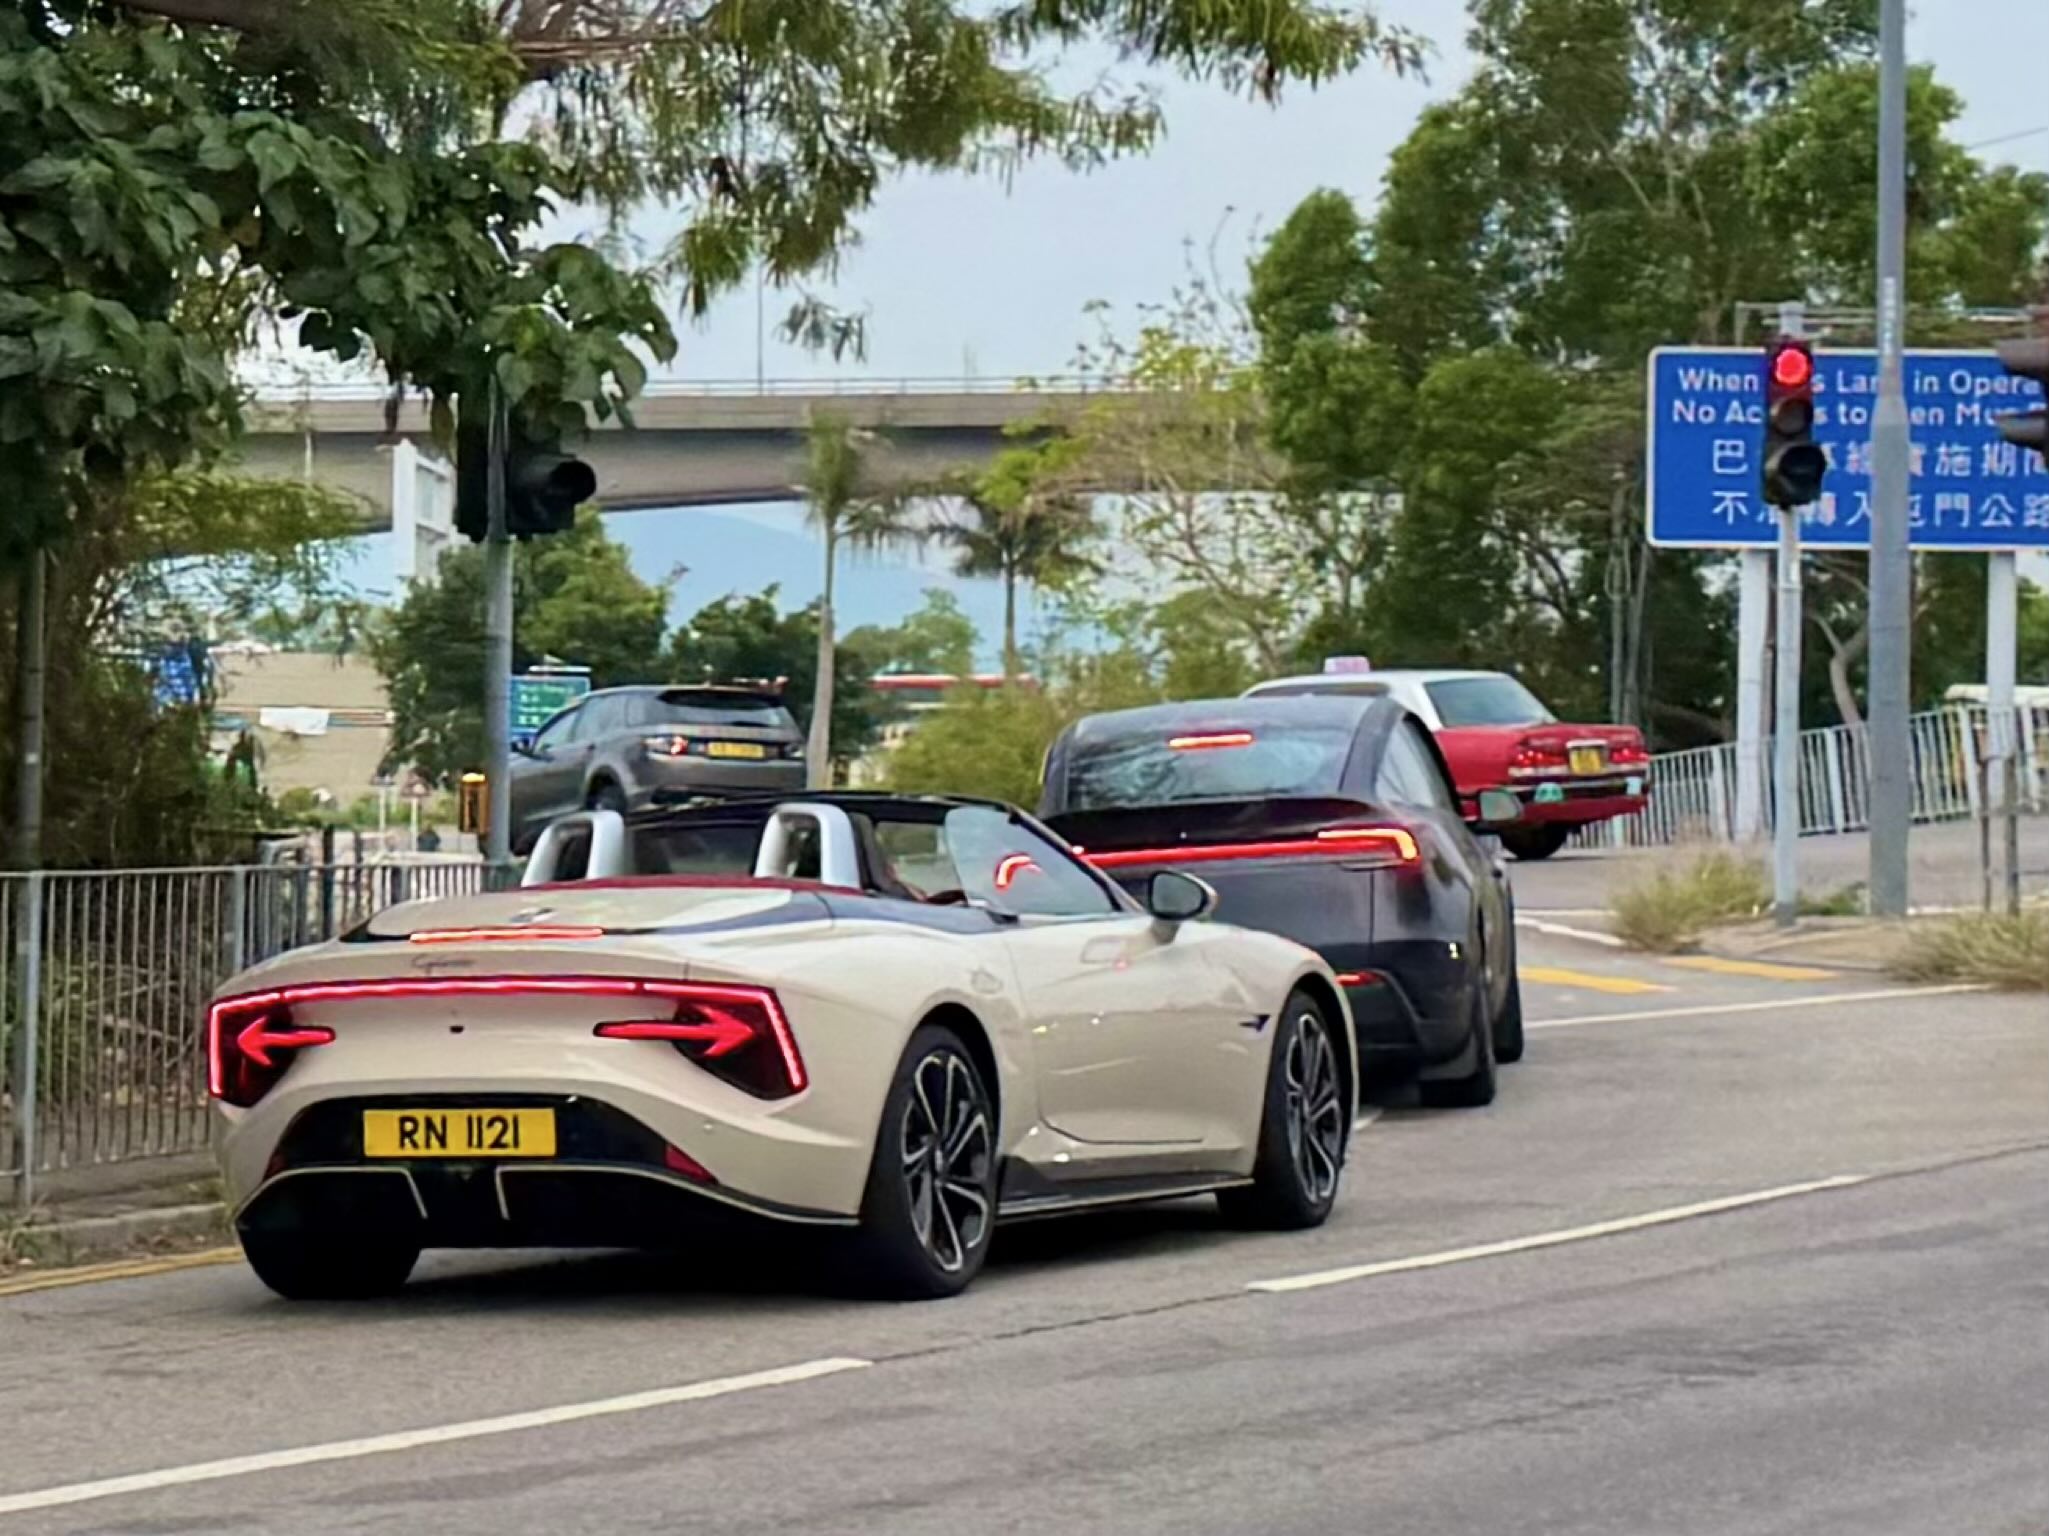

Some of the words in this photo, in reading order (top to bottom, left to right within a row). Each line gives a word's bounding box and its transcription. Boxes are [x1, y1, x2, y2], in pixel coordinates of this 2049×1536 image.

[1677, 368, 1760, 392] When
[1913, 369, 1941, 394] in
[1950, 369, 2043, 401] Opera
[1672, 400, 1717, 424] No
[1724, 400, 1828, 425] Acs
[1837, 402, 1868, 425] to
[398, 1115, 448, 1150] RN
[466, 1114, 521, 1150] 1121
